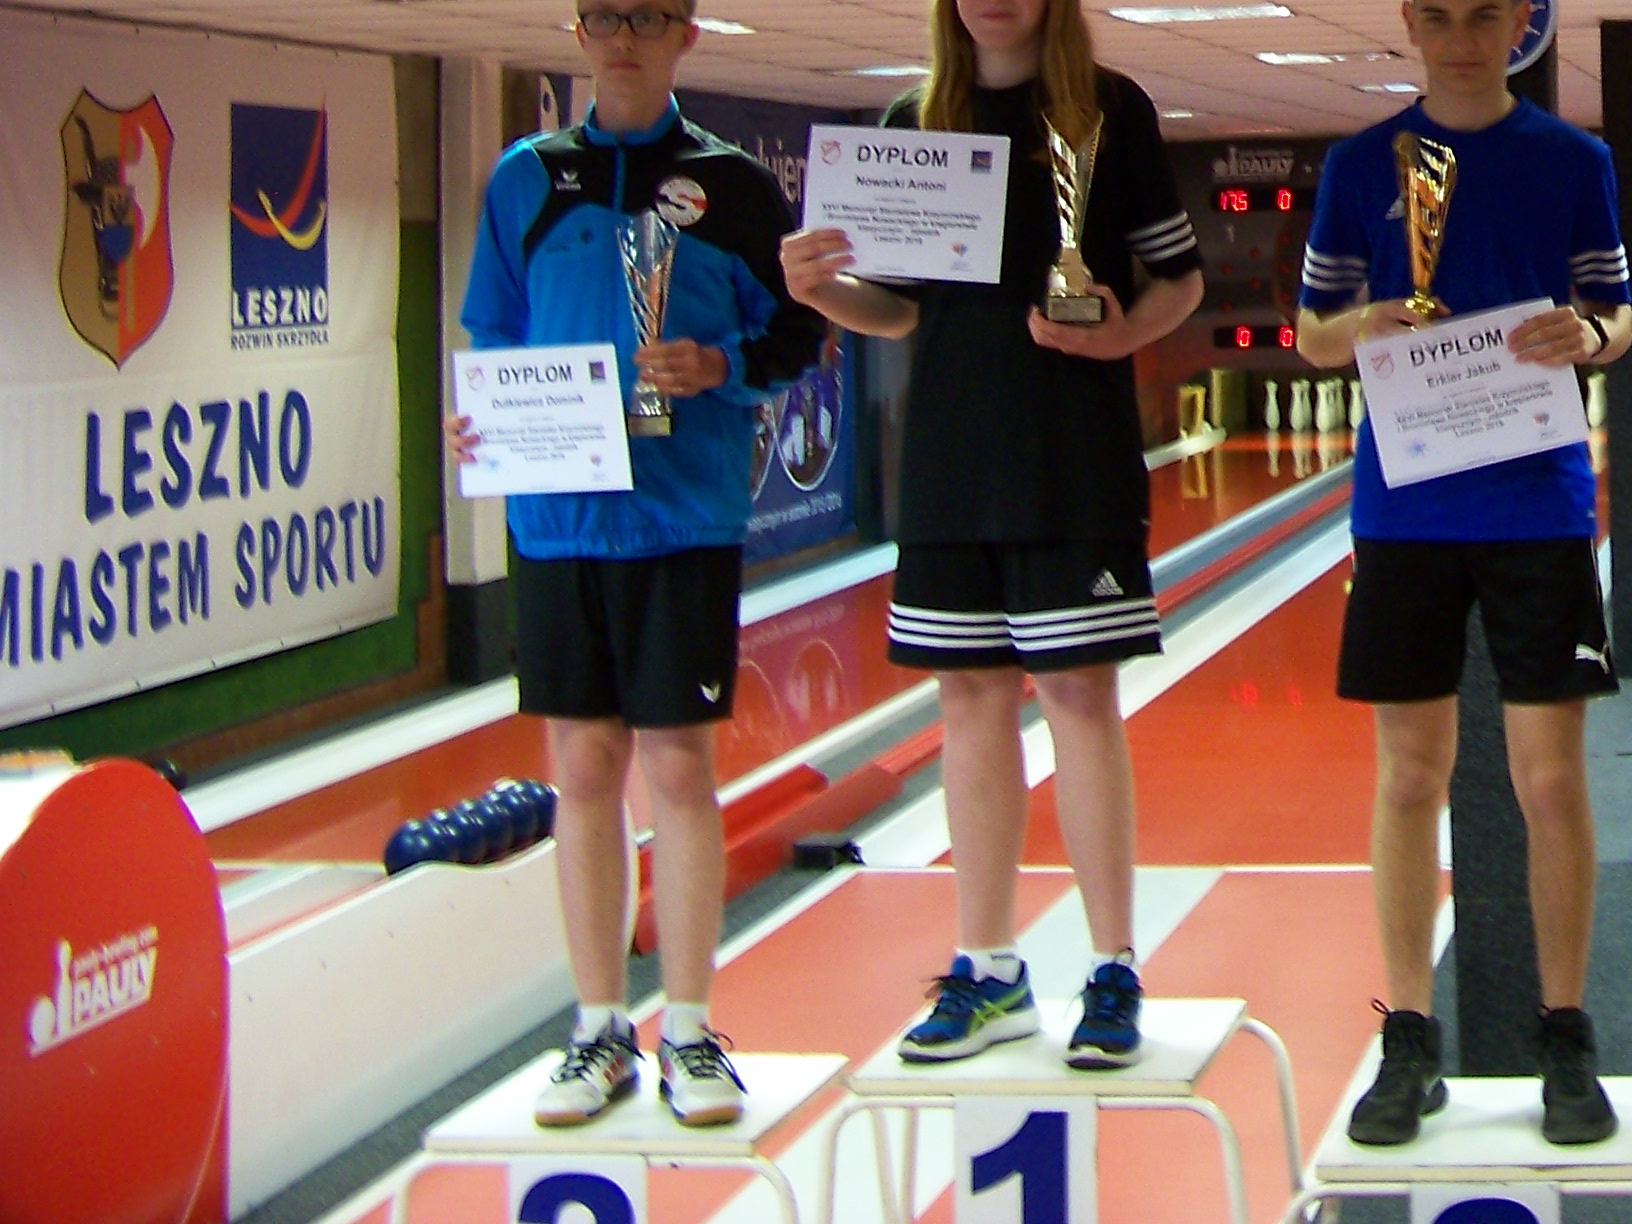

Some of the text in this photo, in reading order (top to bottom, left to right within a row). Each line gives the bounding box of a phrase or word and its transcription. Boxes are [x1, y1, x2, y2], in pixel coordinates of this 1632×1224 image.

[857, 145, 949, 169] DYPLOM
[232, 286, 328, 327] LESZNO
[498, 364, 573, 385] DYPLOM
[1409, 329, 1504, 368] DYPLOM
[85, 389, 312, 524] LESZNO
[234, 495, 385, 610] SPORTU
[74, 946, 157, 1028] PAULY
[970, 1111, 1068, 1224] 1
